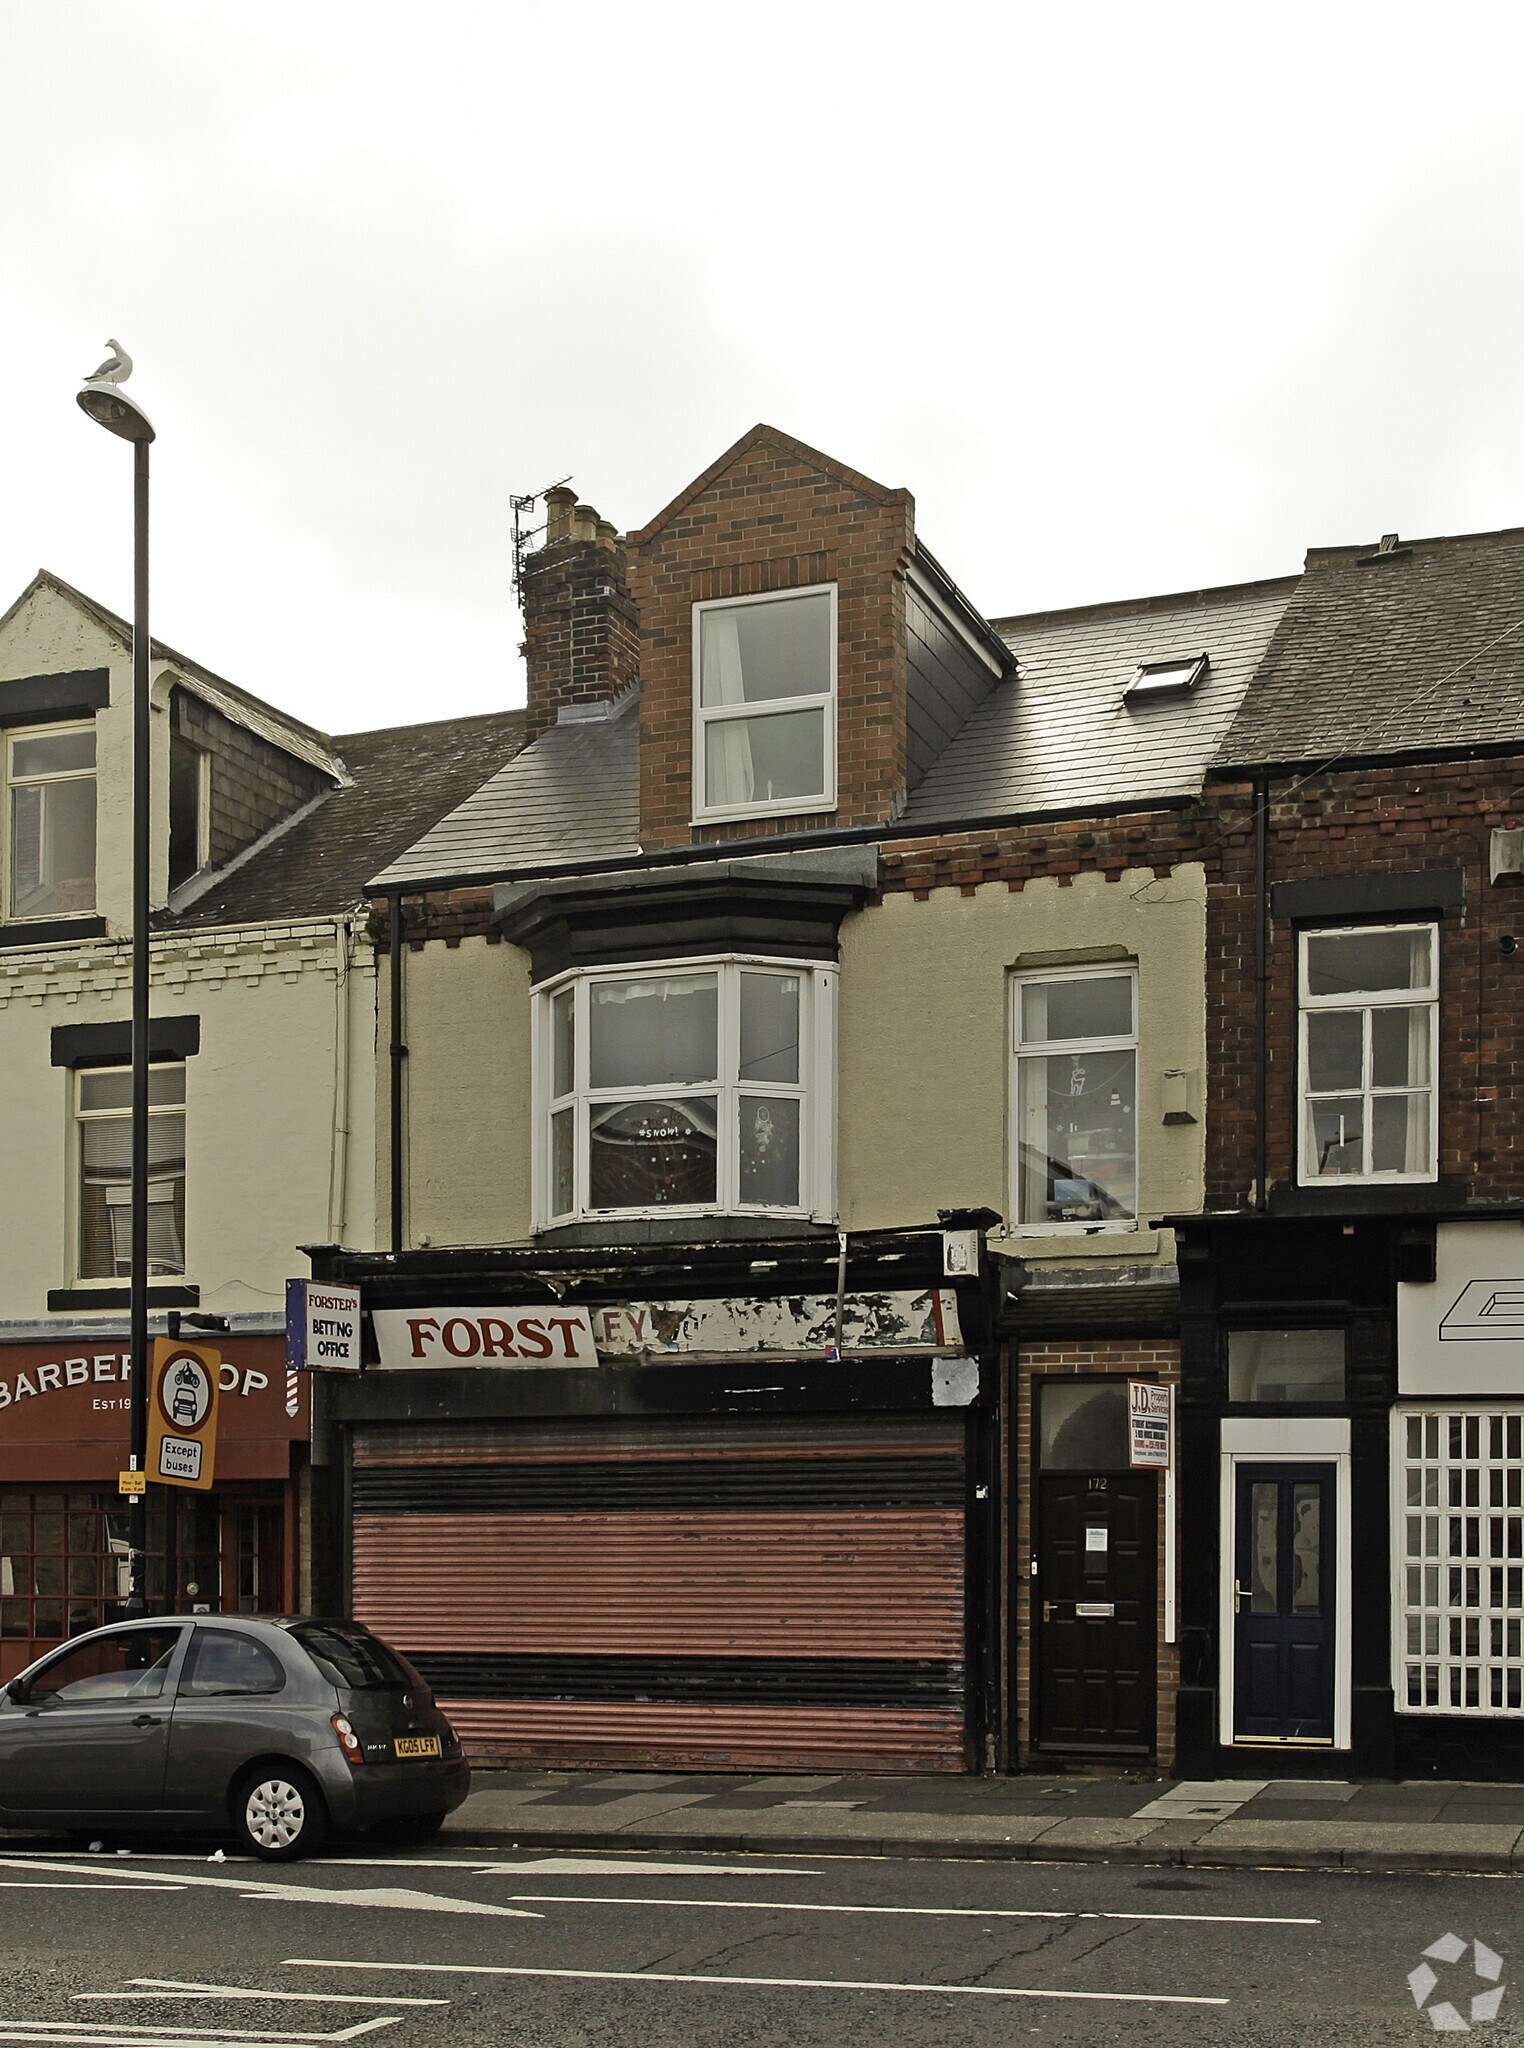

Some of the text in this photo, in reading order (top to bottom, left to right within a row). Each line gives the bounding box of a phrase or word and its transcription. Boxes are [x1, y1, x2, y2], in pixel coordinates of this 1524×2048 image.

[646, 1126, 679, 1138] SNOW!
[313, 1319, 353, 1338] BETTNG
[594, 1310, 647, 1343] EY
[406, 1318, 587, 1358] FORST
[317, 1341, 350, 1358] OFFICE
[165, 1442, 197, 1458] Except
[166, 1459, 193, 1473] buses
[1088, 1478, 1108, 1490] 172
[397, 1739, 419, 1754] KG05
[420, 1738, 436, 1753] LFR
